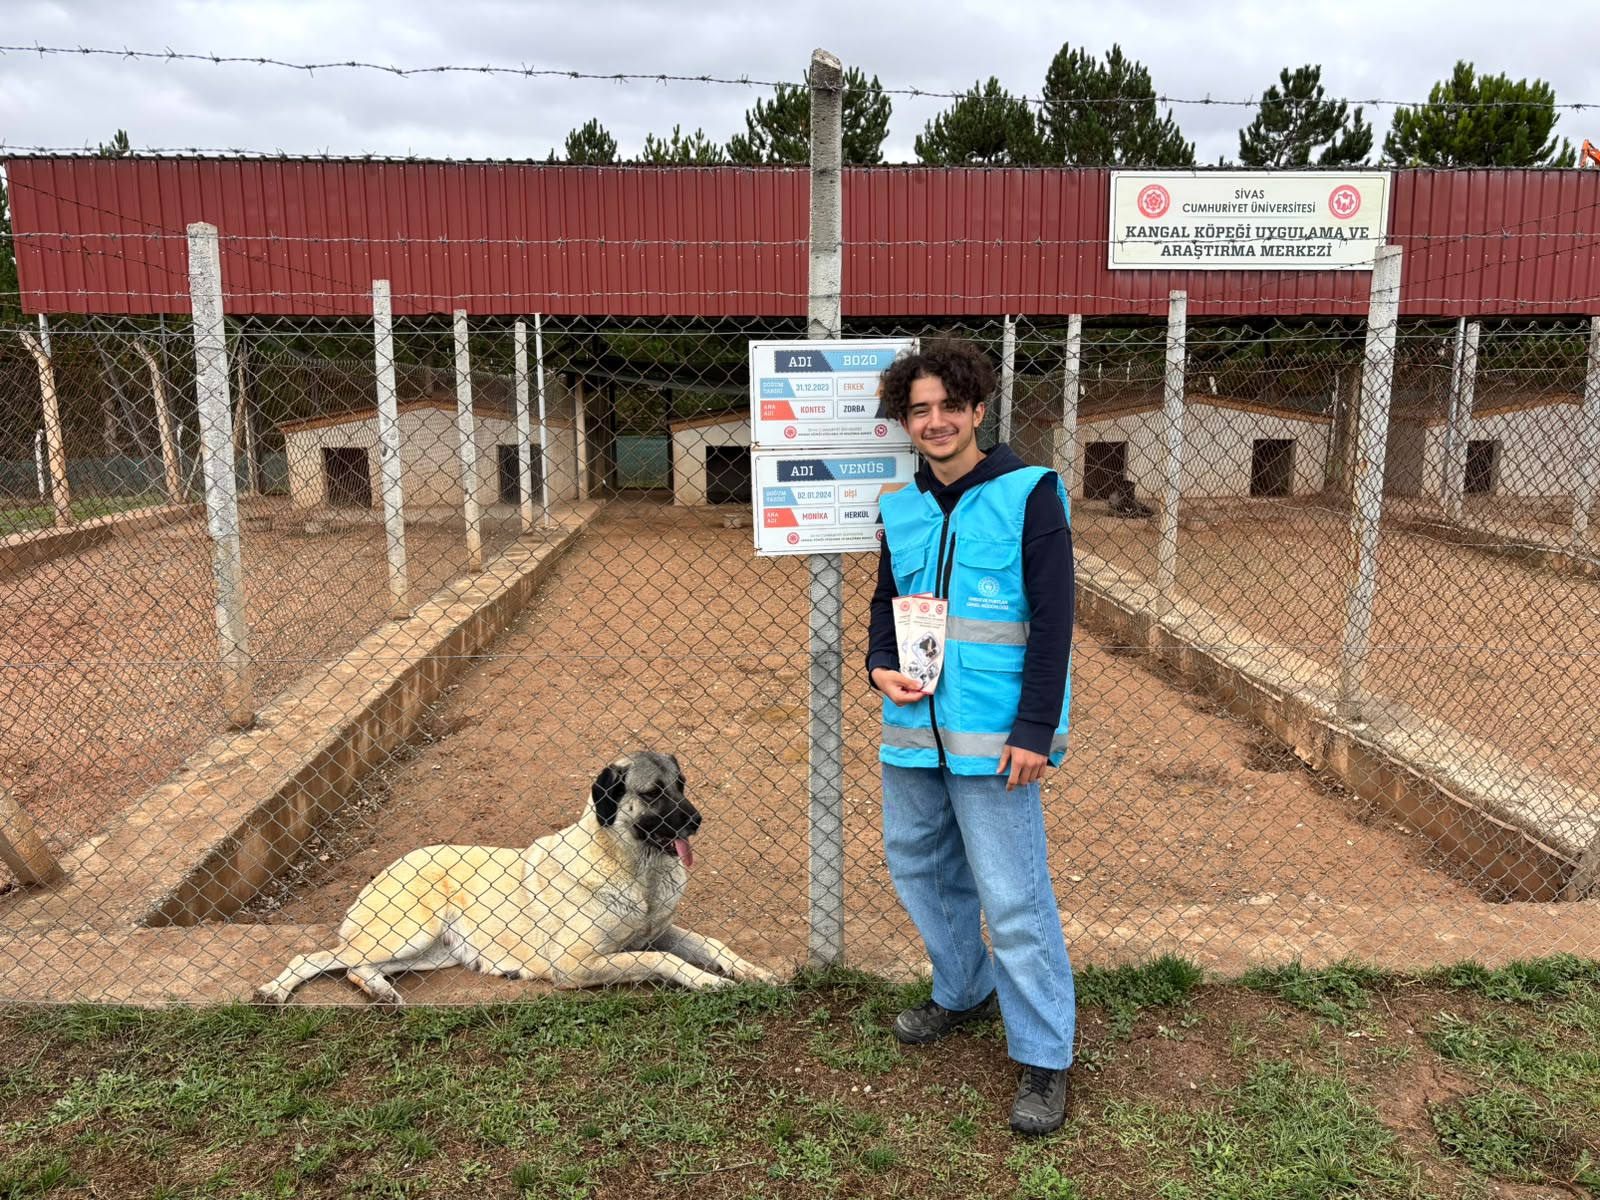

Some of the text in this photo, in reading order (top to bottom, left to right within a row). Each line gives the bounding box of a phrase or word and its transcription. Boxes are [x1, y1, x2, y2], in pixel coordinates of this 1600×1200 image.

[1234, 188, 1265, 200] SİVAS
[1182, 201, 1316, 213] CUMHURİYET ÜNİVERSİTESİ
[1126, 224, 1369, 239] KANGAL KÖPEĞİ UYGULAMA VE
[1161, 242, 1332, 259] ARAŞTIRMA MERKEZİ
[788, 355, 878, 368] ADI BOZO
[843, 382, 865, 391] ERKEK
[800, 405, 826, 414] KONTES
[843, 405, 866, 413] ZORBA
[790, 461, 884, 477] ADI VENÜS
[797, 491, 832, 499] 02.01.2024
[843, 488, 857, 499] DİŞİ
[802, 512, 828, 520] MONİKA
[844, 508, 870, 519] HERKÜL
